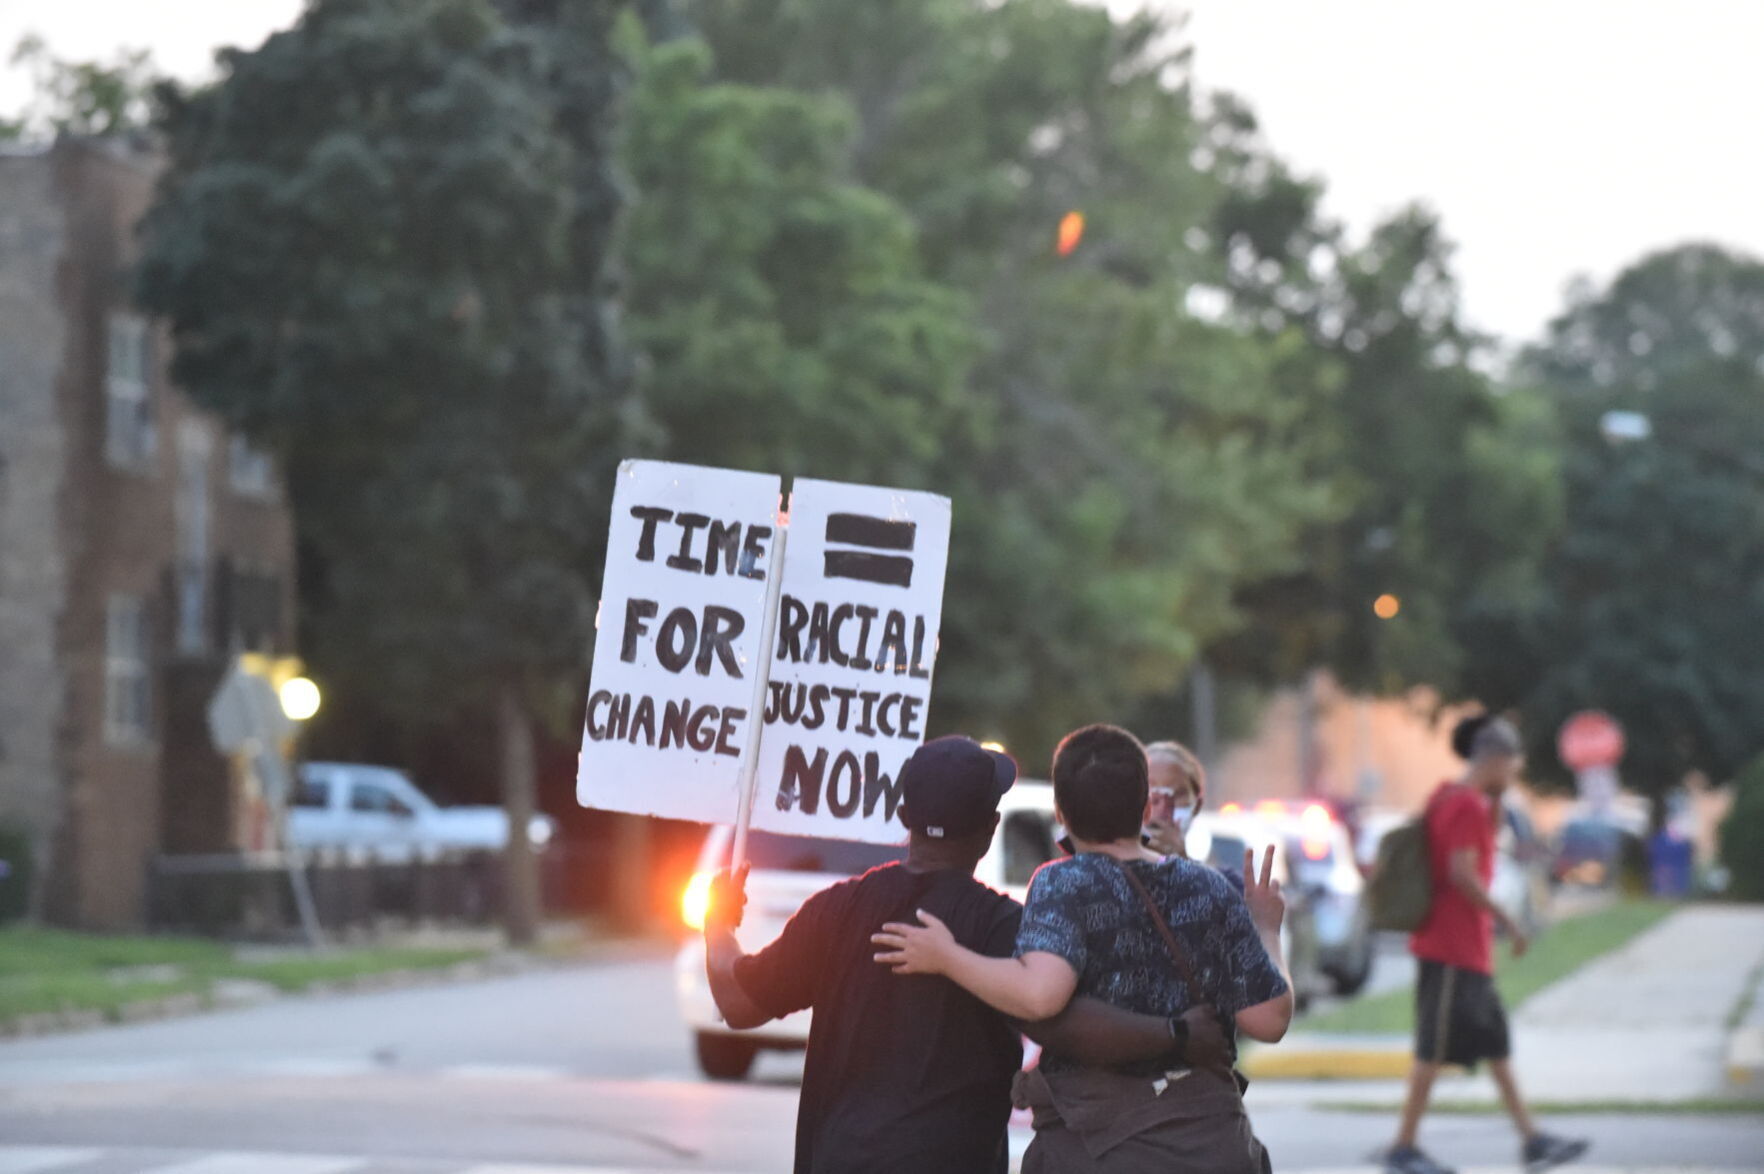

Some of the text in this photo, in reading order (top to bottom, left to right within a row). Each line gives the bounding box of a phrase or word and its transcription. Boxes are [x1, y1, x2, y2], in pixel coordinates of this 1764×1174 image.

[630, 505, 772, 581] TIME
[620, 598, 745, 679] FOR
[776, 594, 929, 679] RACIAL
[586, 689, 747, 758] CHANGE
[763, 680, 923, 740] JUSTICE
[775, 744, 912, 823] NOW
